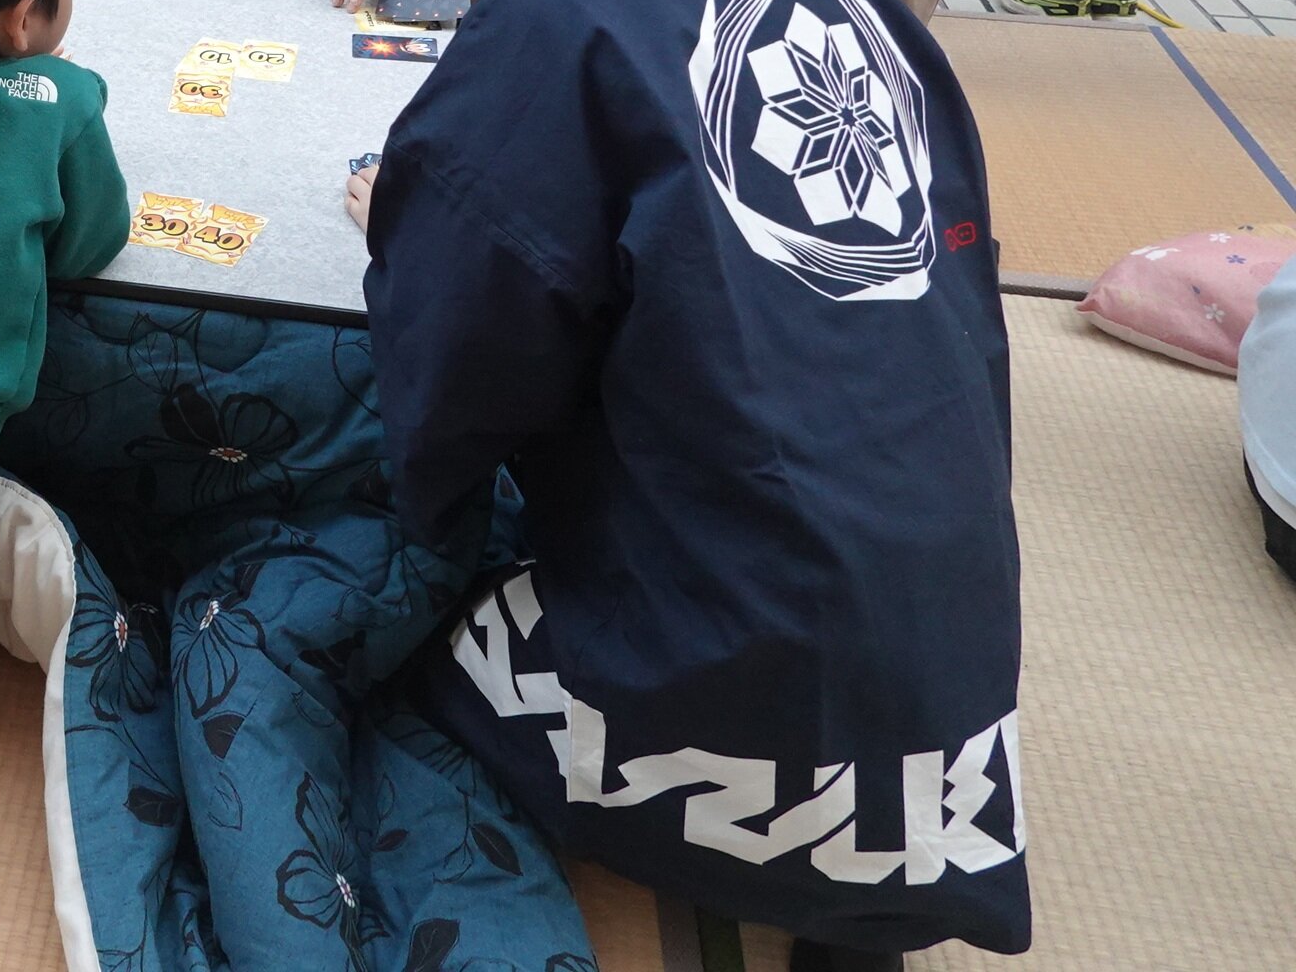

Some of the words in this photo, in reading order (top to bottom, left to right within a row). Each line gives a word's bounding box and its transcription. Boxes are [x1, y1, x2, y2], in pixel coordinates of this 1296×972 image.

[200, 50, 233, 64] 10
[249, 51, 285, 65] 20
[17, 72, 39, 83] THE
[8, 89, 36, 100] FACE
[180, 82, 223, 99] 30
[140, 214, 189, 236] 30
[194, 226, 245, 250] 40
